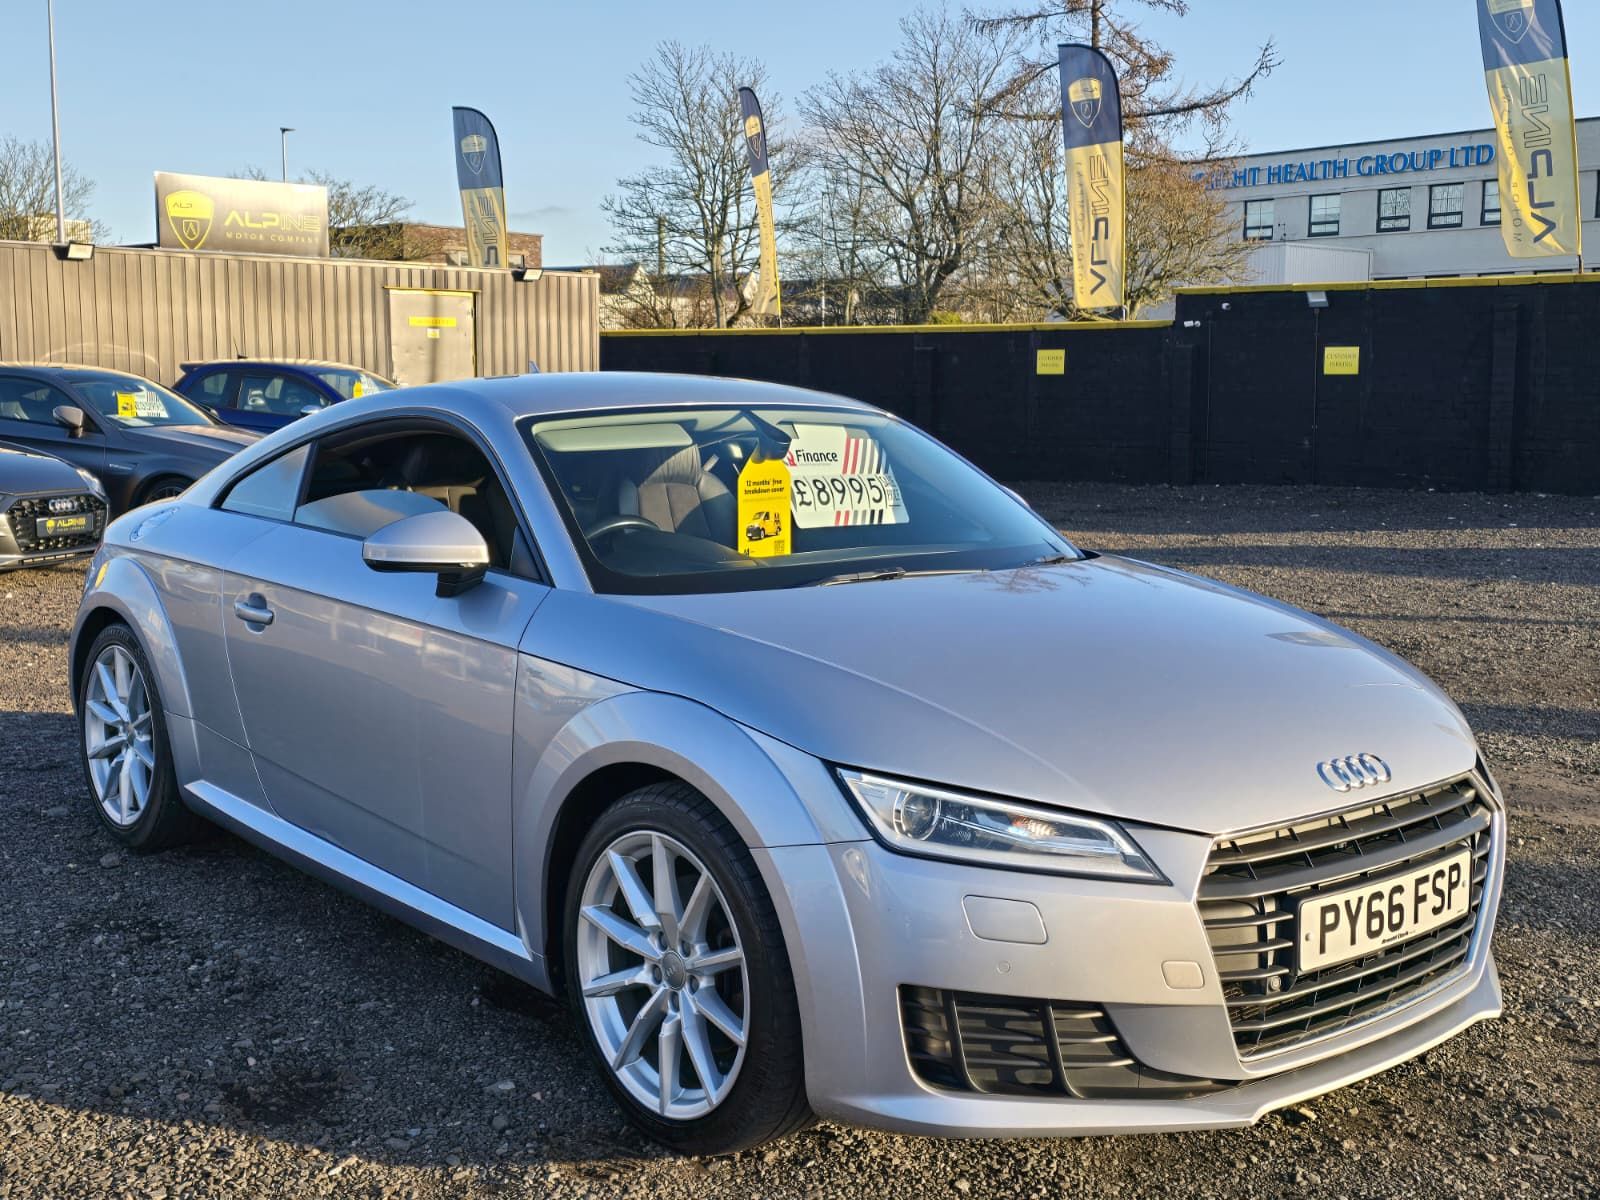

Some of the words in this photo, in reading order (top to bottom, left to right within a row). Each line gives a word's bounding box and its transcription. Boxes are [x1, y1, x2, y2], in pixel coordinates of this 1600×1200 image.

[1267, 158, 1349, 184] HEALTH
[1356, 149, 1443, 175] GROUP
[1449, 144, 1495, 167] LTD
[224, 209, 321, 233] ALPINE
[226, 231, 265, 241] MOTOR
[795, 448, 838, 463] Finance
[793, 474, 883, 506] £8995
[1319, 884, 1405, 955] PY66
[1413, 862, 1461, 925] FSP
